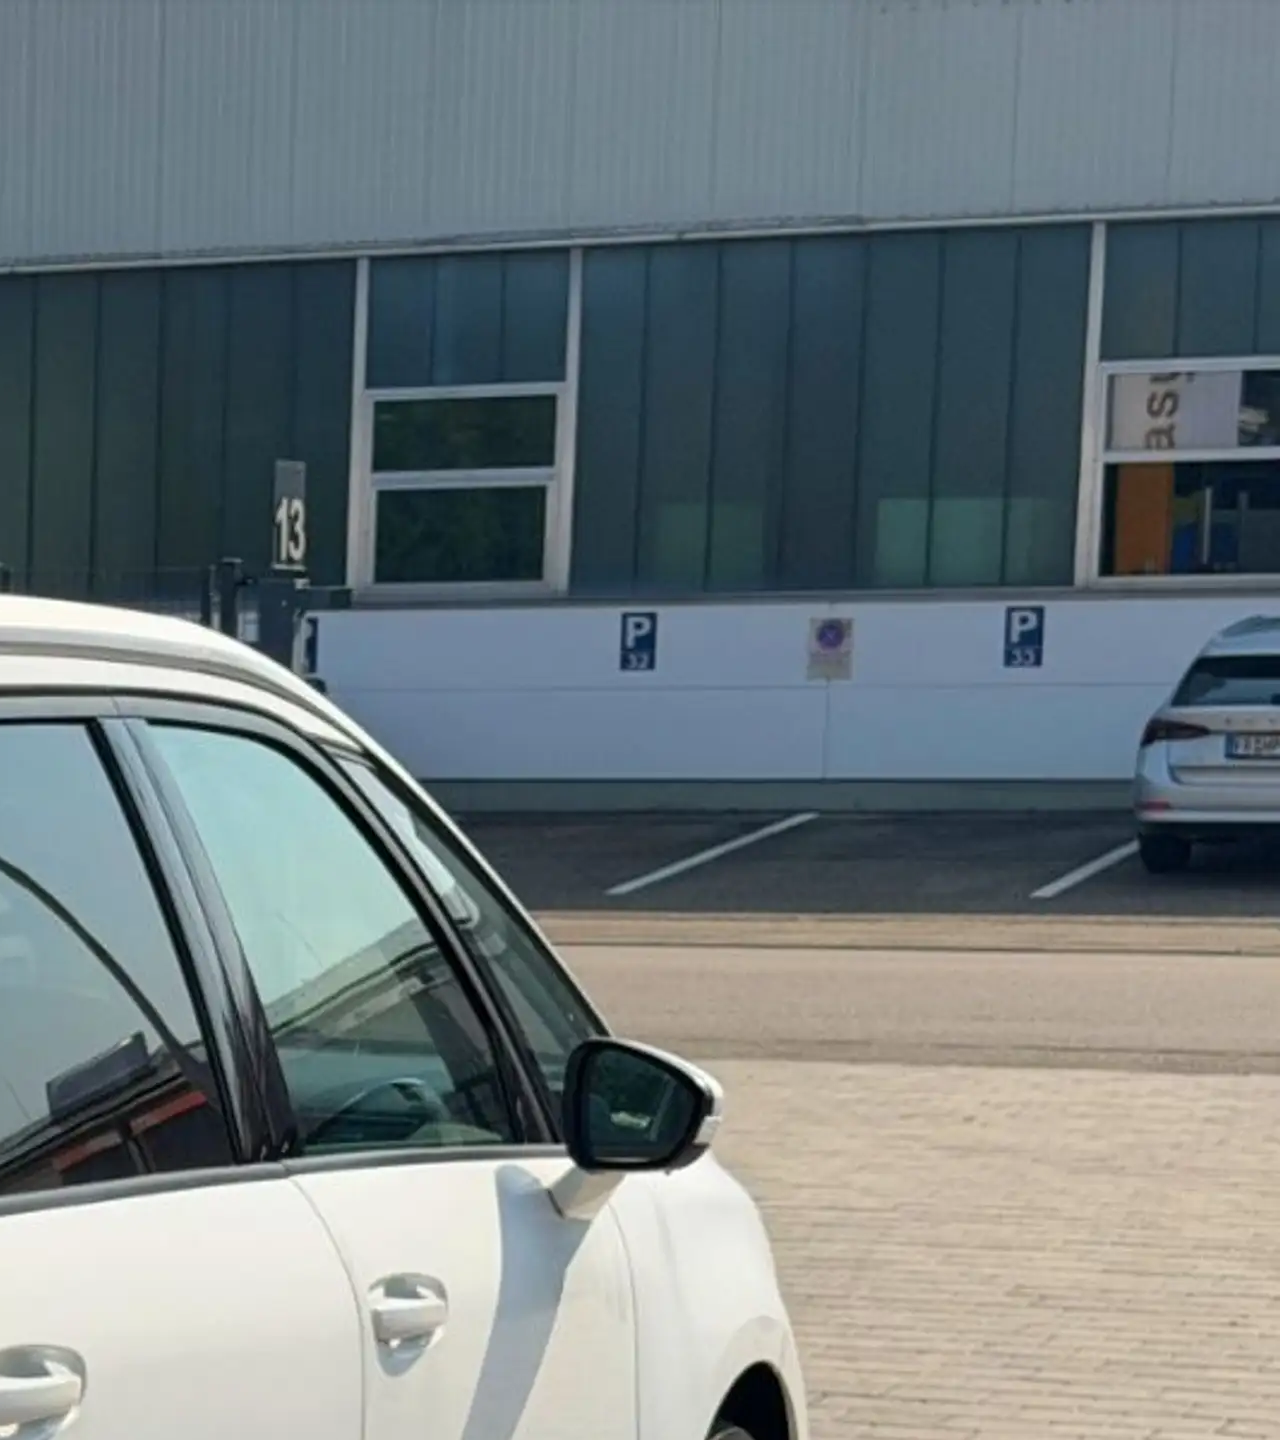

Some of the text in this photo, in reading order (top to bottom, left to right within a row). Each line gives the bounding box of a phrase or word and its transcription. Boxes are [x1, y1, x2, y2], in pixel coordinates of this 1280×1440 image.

[274, 496, 306, 562] 13
[625, 616, 652, 650] P
[1010, 611, 1038, 644] P
